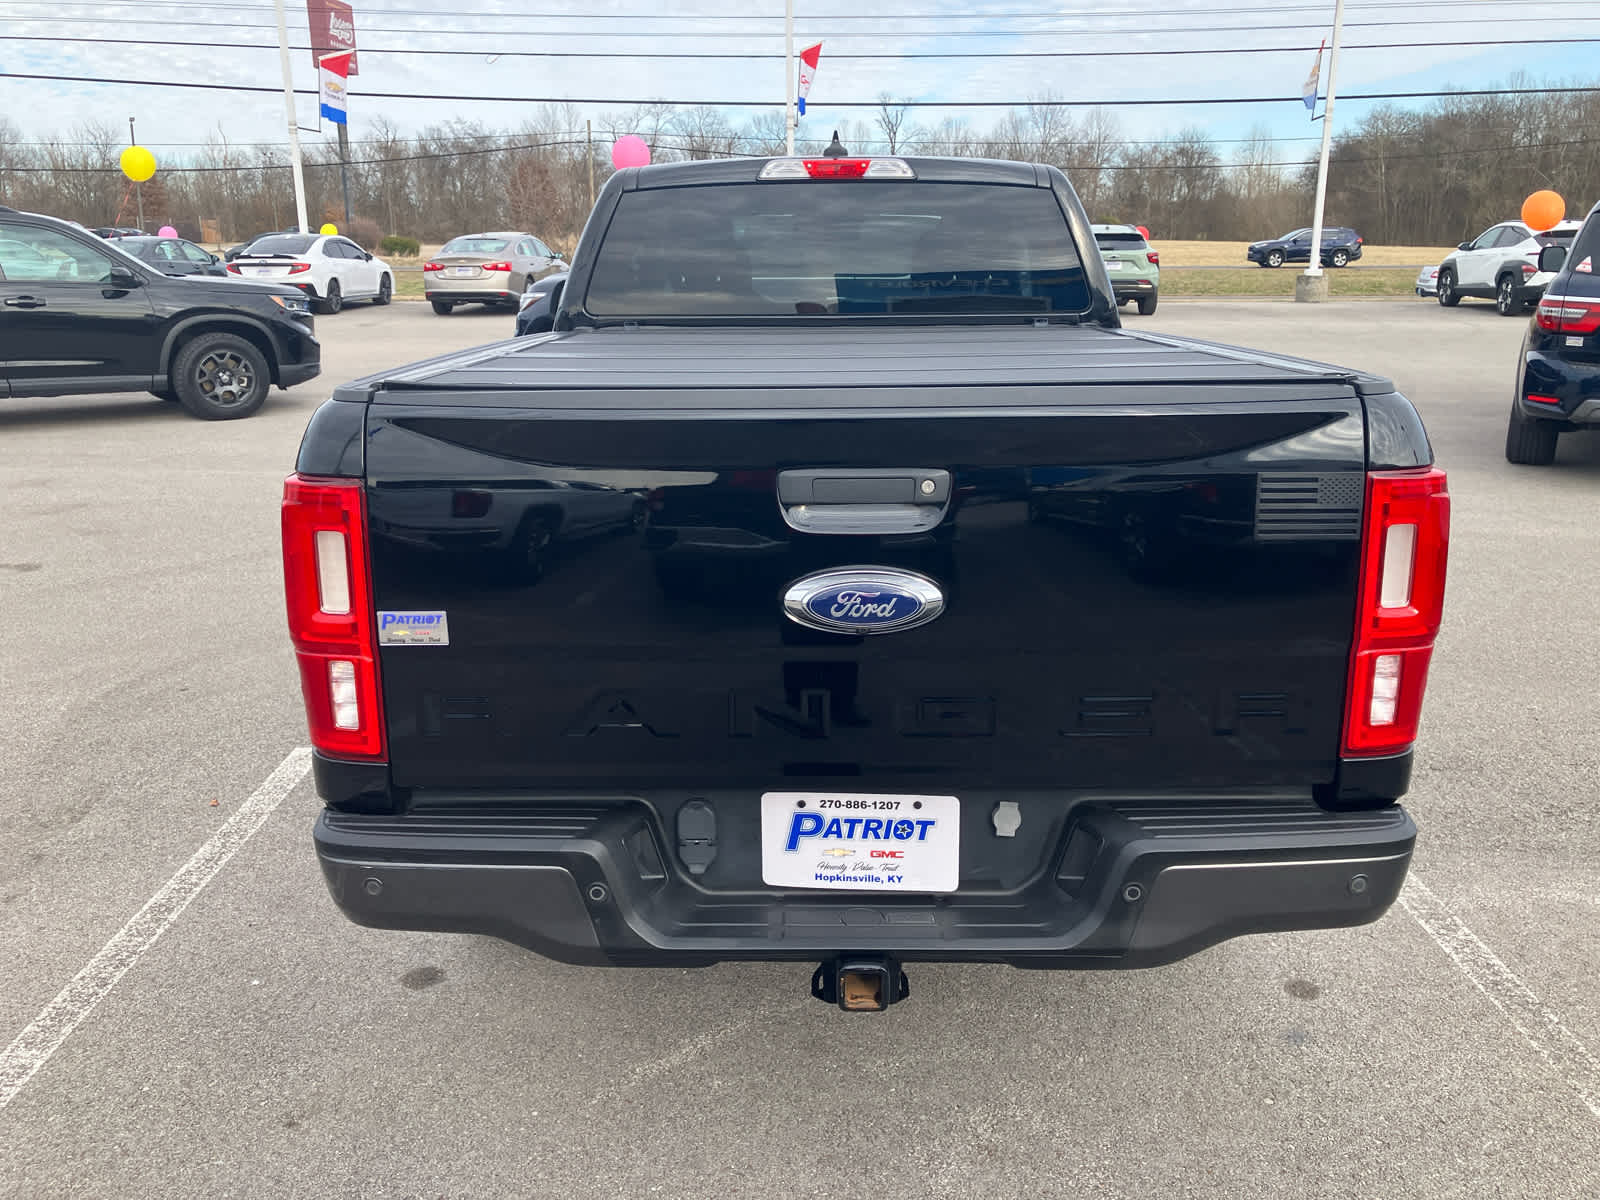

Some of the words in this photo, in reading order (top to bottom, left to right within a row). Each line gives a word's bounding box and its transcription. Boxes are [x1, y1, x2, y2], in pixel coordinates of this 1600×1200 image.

[830, 590, 898, 618] Ford
[381, 613, 443, 630] PATRIOT
[422, 688, 1308, 737] RANGER
[819, 799, 901, 810] 270-886-1207
[785, 811, 936, 852] PATRIOT
[870, 850, 904, 858] GMC
[815, 873, 884, 884] Hopkinsville,
[887, 875, 903, 883] KY
